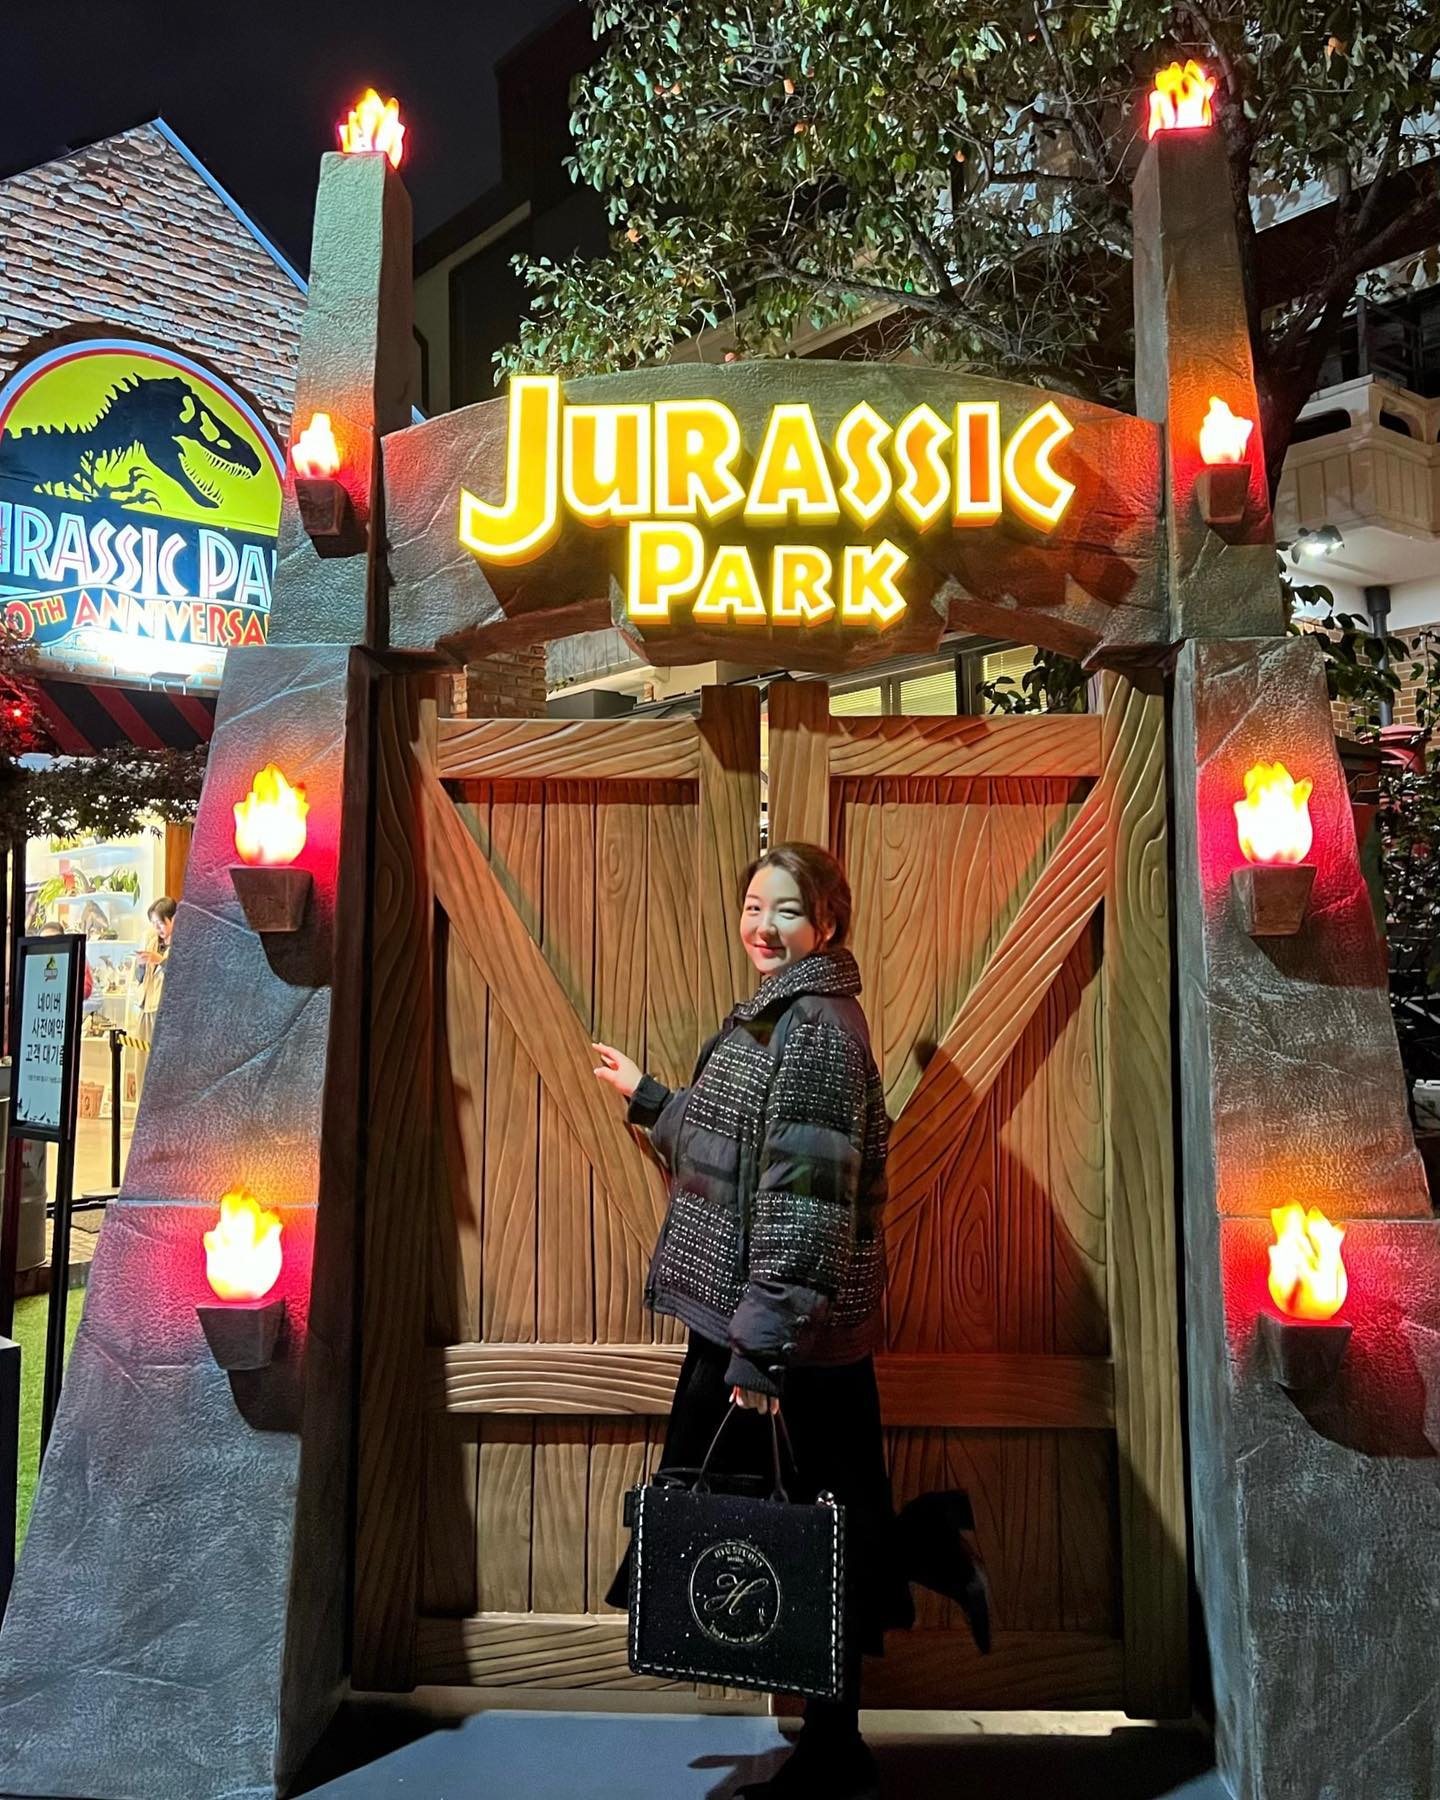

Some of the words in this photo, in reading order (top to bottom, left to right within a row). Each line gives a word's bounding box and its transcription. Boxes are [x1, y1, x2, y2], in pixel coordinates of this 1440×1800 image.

[459, 375, 1076, 562] JURASSIC
[198, 528, 277, 611] PA
[627, 520, 911, 629] PARK
[73, 588, 271, 646] ANNIVERSA
[31, 1018, 64, 1039] 사전예약
[37, 992, 61, 1012] 네이버
[25, 1043, 41, 1065] 고객
